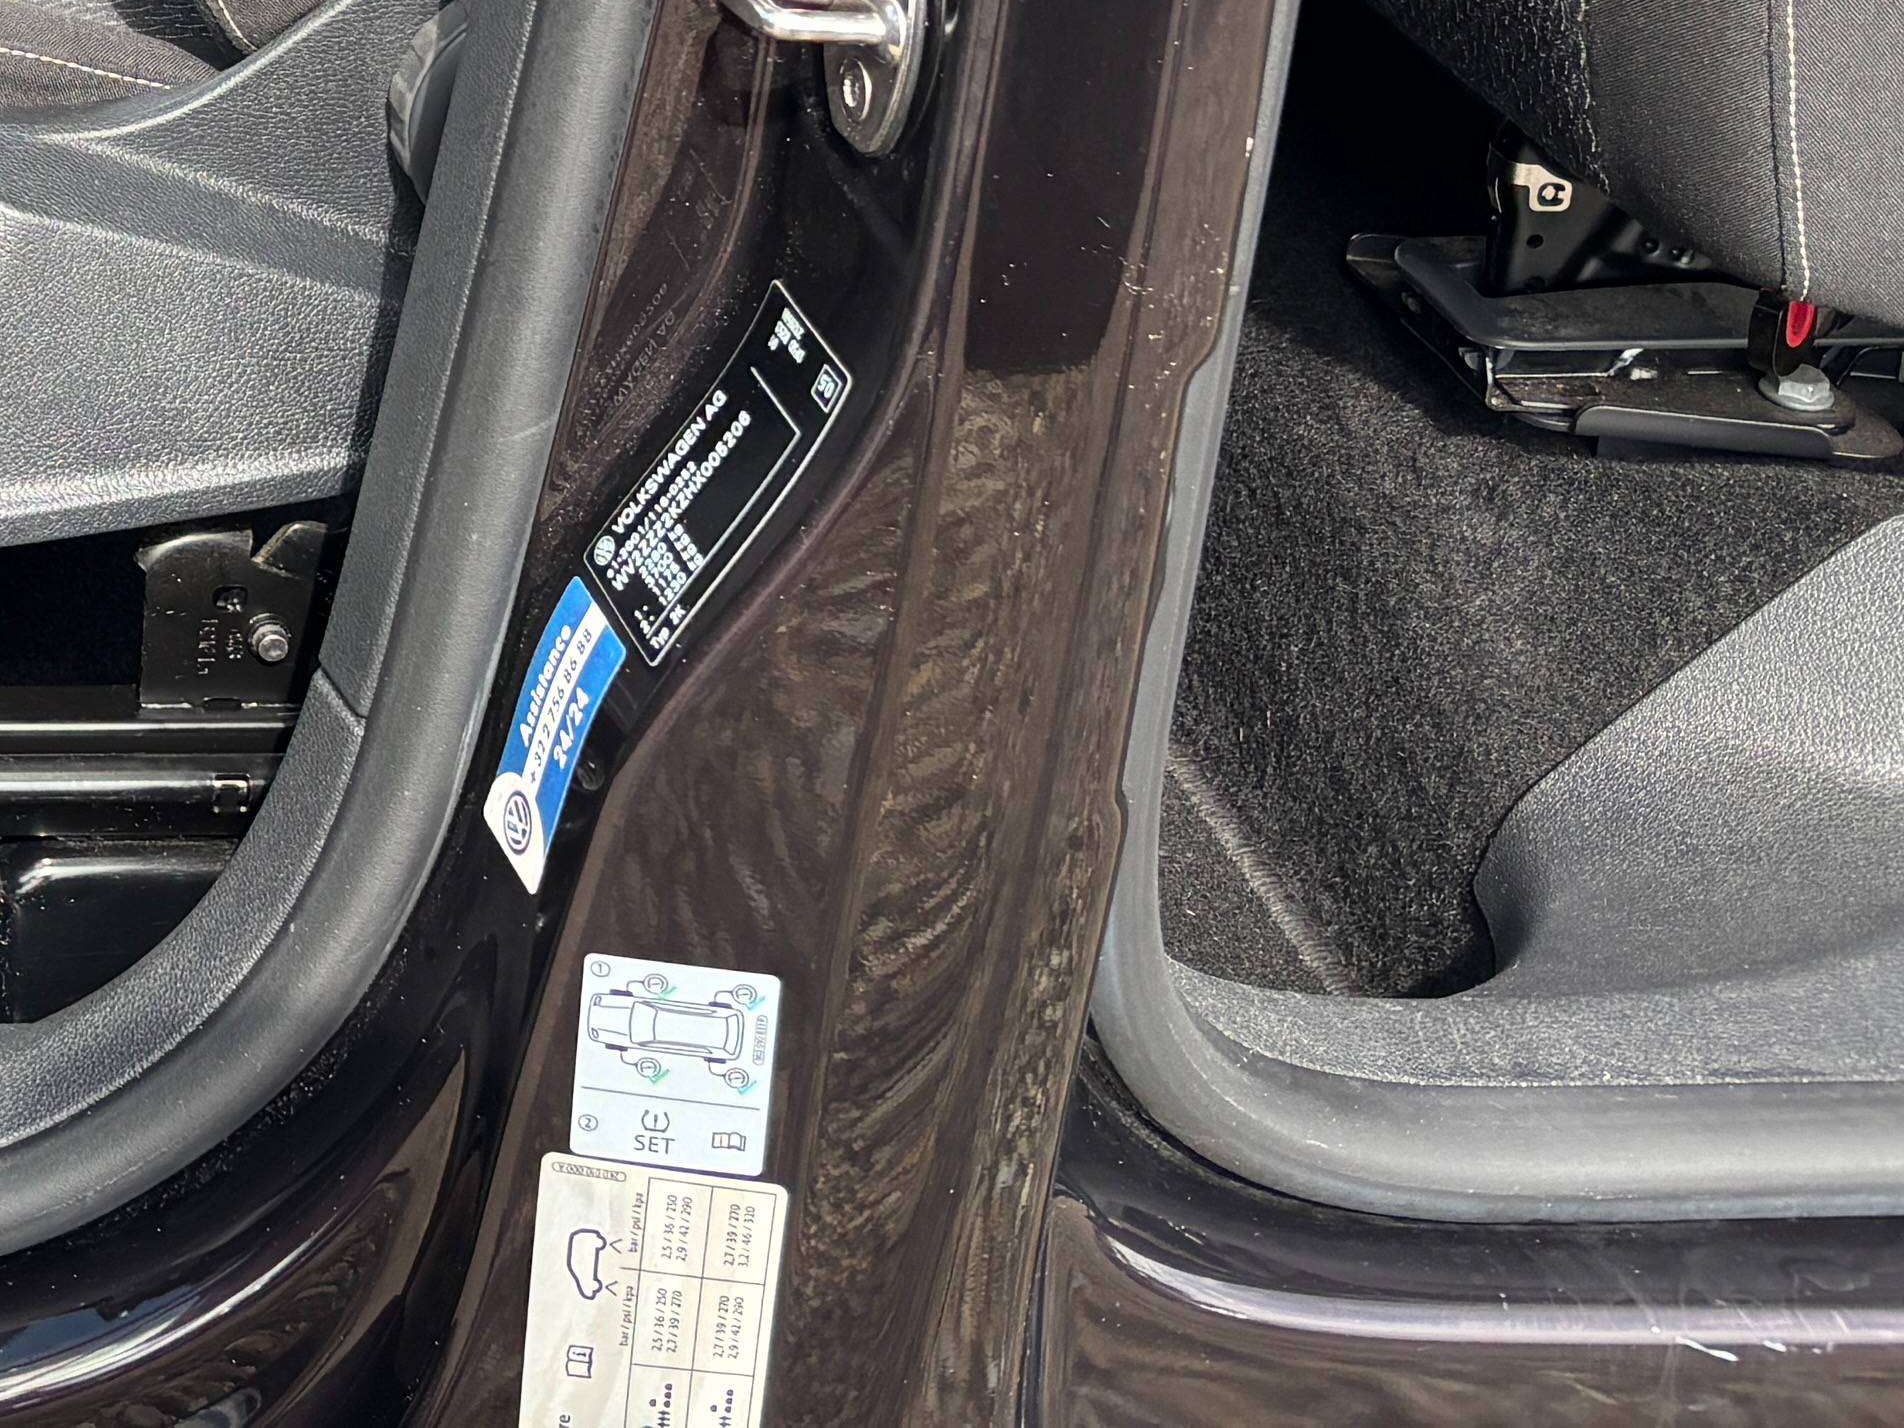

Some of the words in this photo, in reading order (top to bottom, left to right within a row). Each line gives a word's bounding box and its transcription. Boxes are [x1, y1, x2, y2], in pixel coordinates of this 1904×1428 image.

[612, 416, 707, 534] VOLKSWAGEN
[704, 389, 728, 422] AG
[520, 625, 571, 748] Assistance
[547, 686, 565, 722] 756
[563, 659, 577, 684] 86
[576, 628, 592, 656] 88
[553, 687, 589, 770] 24/24
[634, 1134, 675, 1154] SET
